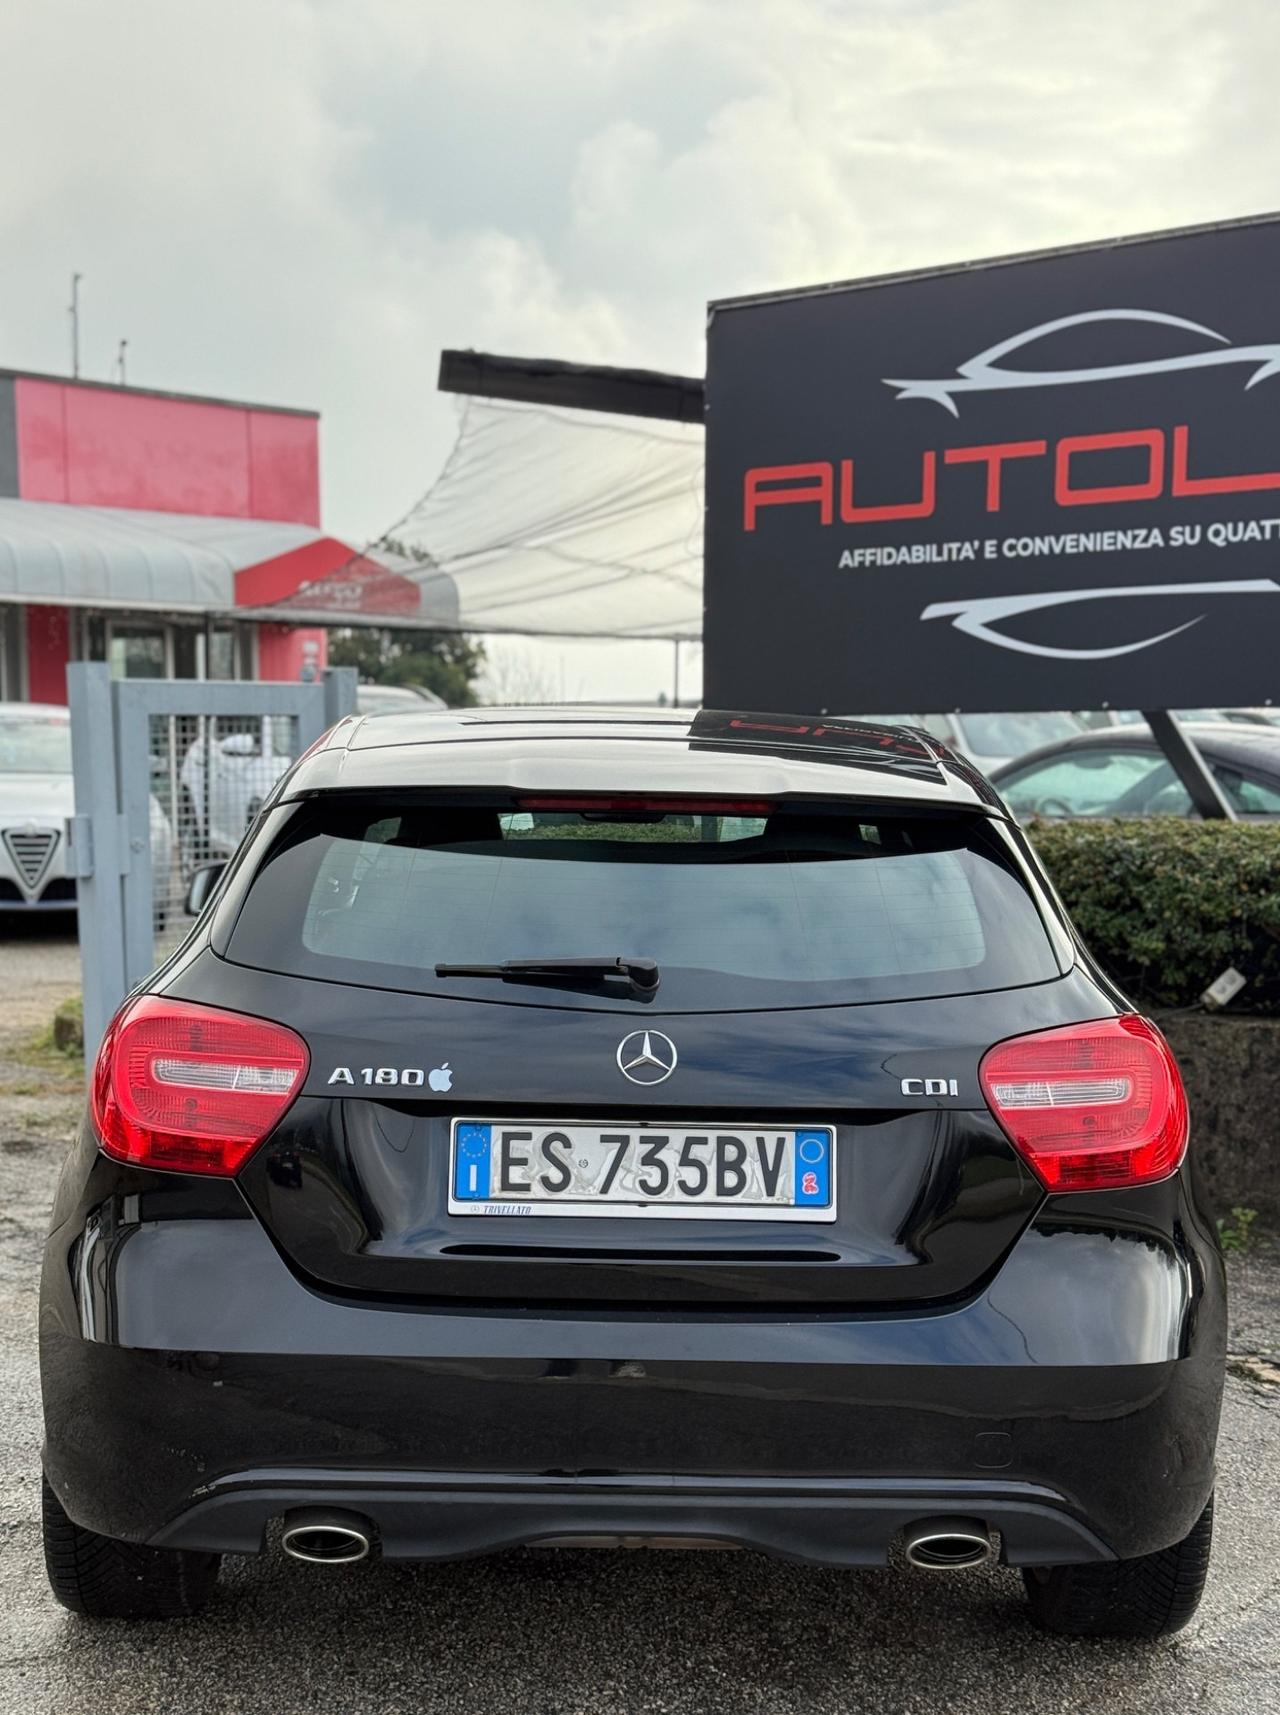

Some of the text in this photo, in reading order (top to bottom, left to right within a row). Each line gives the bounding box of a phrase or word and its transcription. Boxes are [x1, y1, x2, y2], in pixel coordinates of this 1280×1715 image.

[838, 540, 979, 568] AFFIDABILITA'
[984, 539, 998, 559] E
[1002, 528, 1165, 556] CONVENIENZA
[1169, 525, 1201, 547] SU
[327, 1067, 425, 1086] A 180
[901, 1078, 958, 1097] CDI
[500, 1131, 786, 1198] ES 735BV
[469, 1164, 477, 1192] I
[484, 1205, 532, 1216] TRIVELLATO
